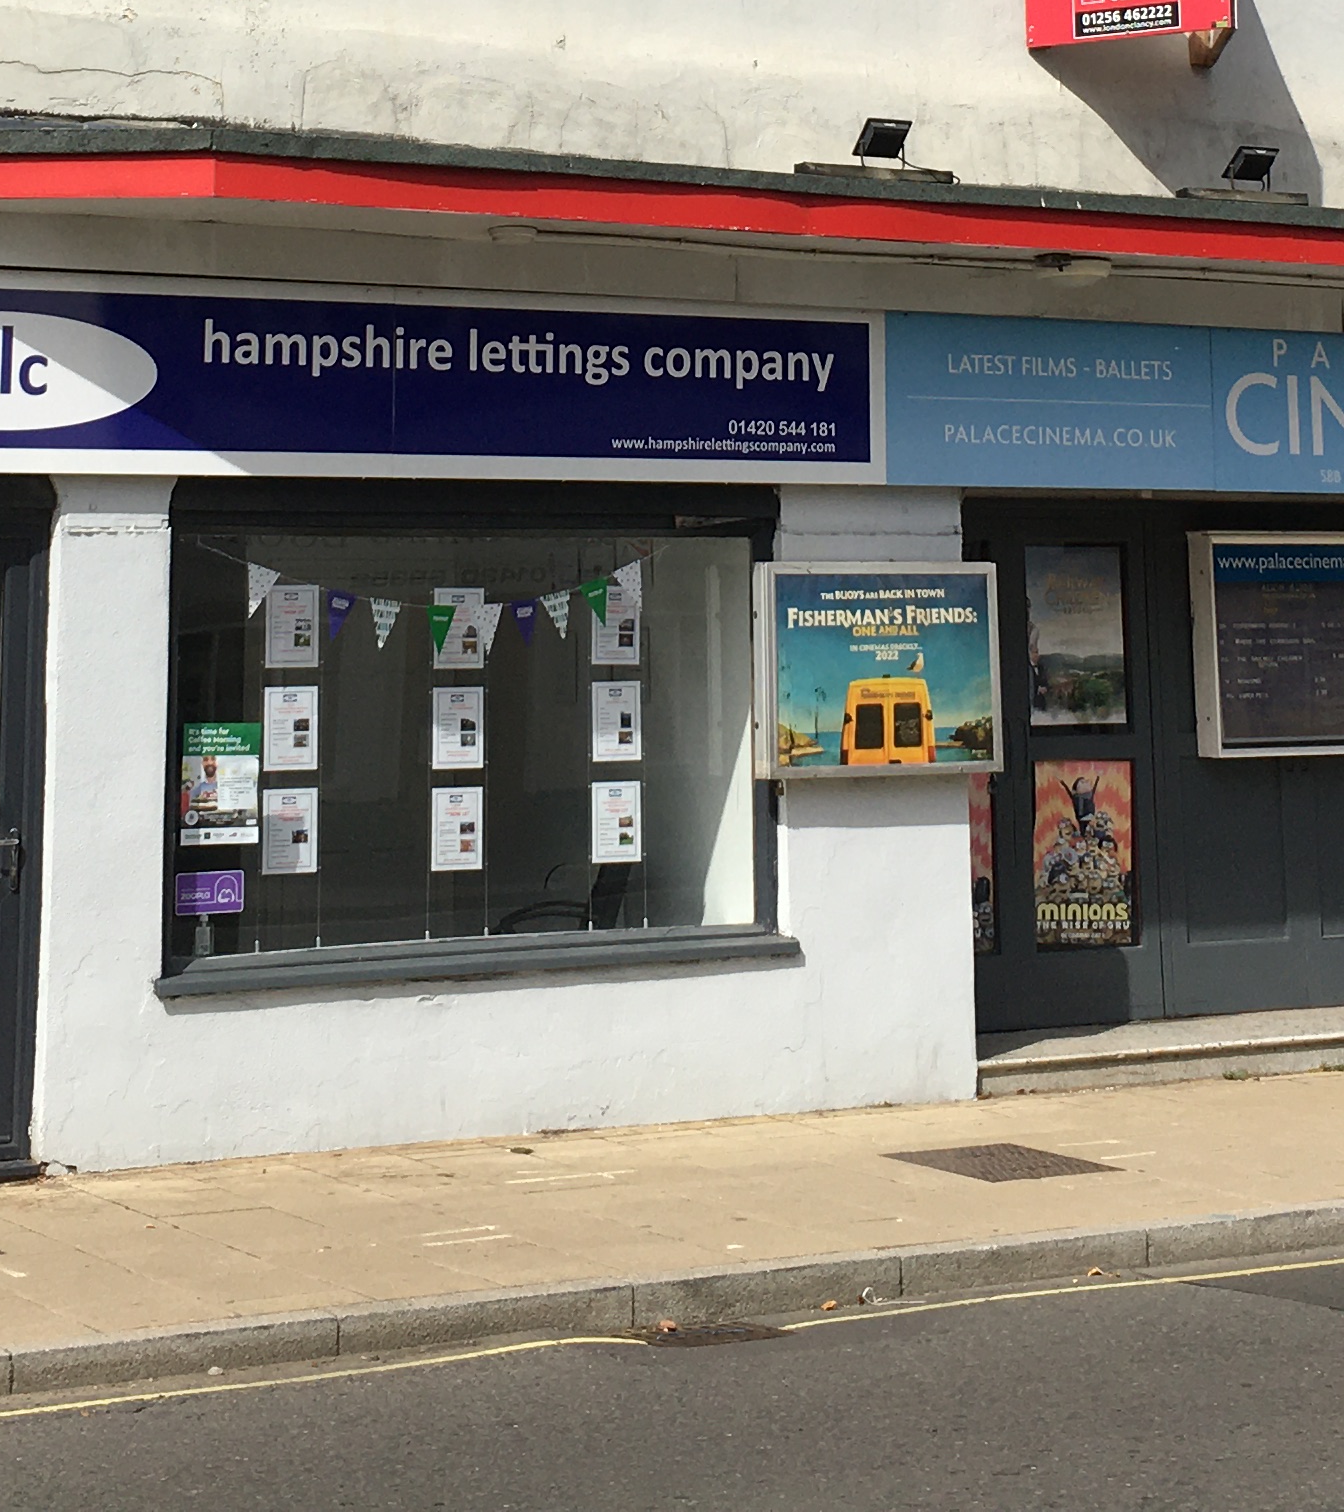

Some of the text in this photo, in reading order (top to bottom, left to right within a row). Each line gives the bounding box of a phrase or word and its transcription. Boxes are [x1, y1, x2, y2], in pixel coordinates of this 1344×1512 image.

[1082, 5, 1172, 26] 01256 462222
[1083, 19, 1172, 33] www.londonclancy.com
[203, 318, 835, 392] hampshire lettings company
[948, 353, 1016, 376] LATEST
[1022, 356, 1077, 378] FILMS
[1096, 359, 1173, 382] BALLETS
[728, 419, 837, 438] 01420 544 181
[944, 423, 1177, 449] PALACECINEMA.CO.UK
[611, 436, 836, 455] www.hampshirelettingscompany.com
[820, 592, 834, 600] THE
[879, 589, 903, 599] BACK
[905, 589, 915, 598] IN
[917, 588, 945, 598] TOWN
[787, 605, 978, 629] FISHERMAN'S FRIENDS:
[852, 625, 919, 637] ONE AND ALL
[875, 650, 899, 660] 2022
[201, 727, 217, 735] time
[218, 726, 230, 735] for
[188, 735, 212, 743] Coffee
[188, 744, 201, 752] and
[225, 743, 251, 752] invited
[1036, 919, 1130, 930] THE RISE OF GRU
